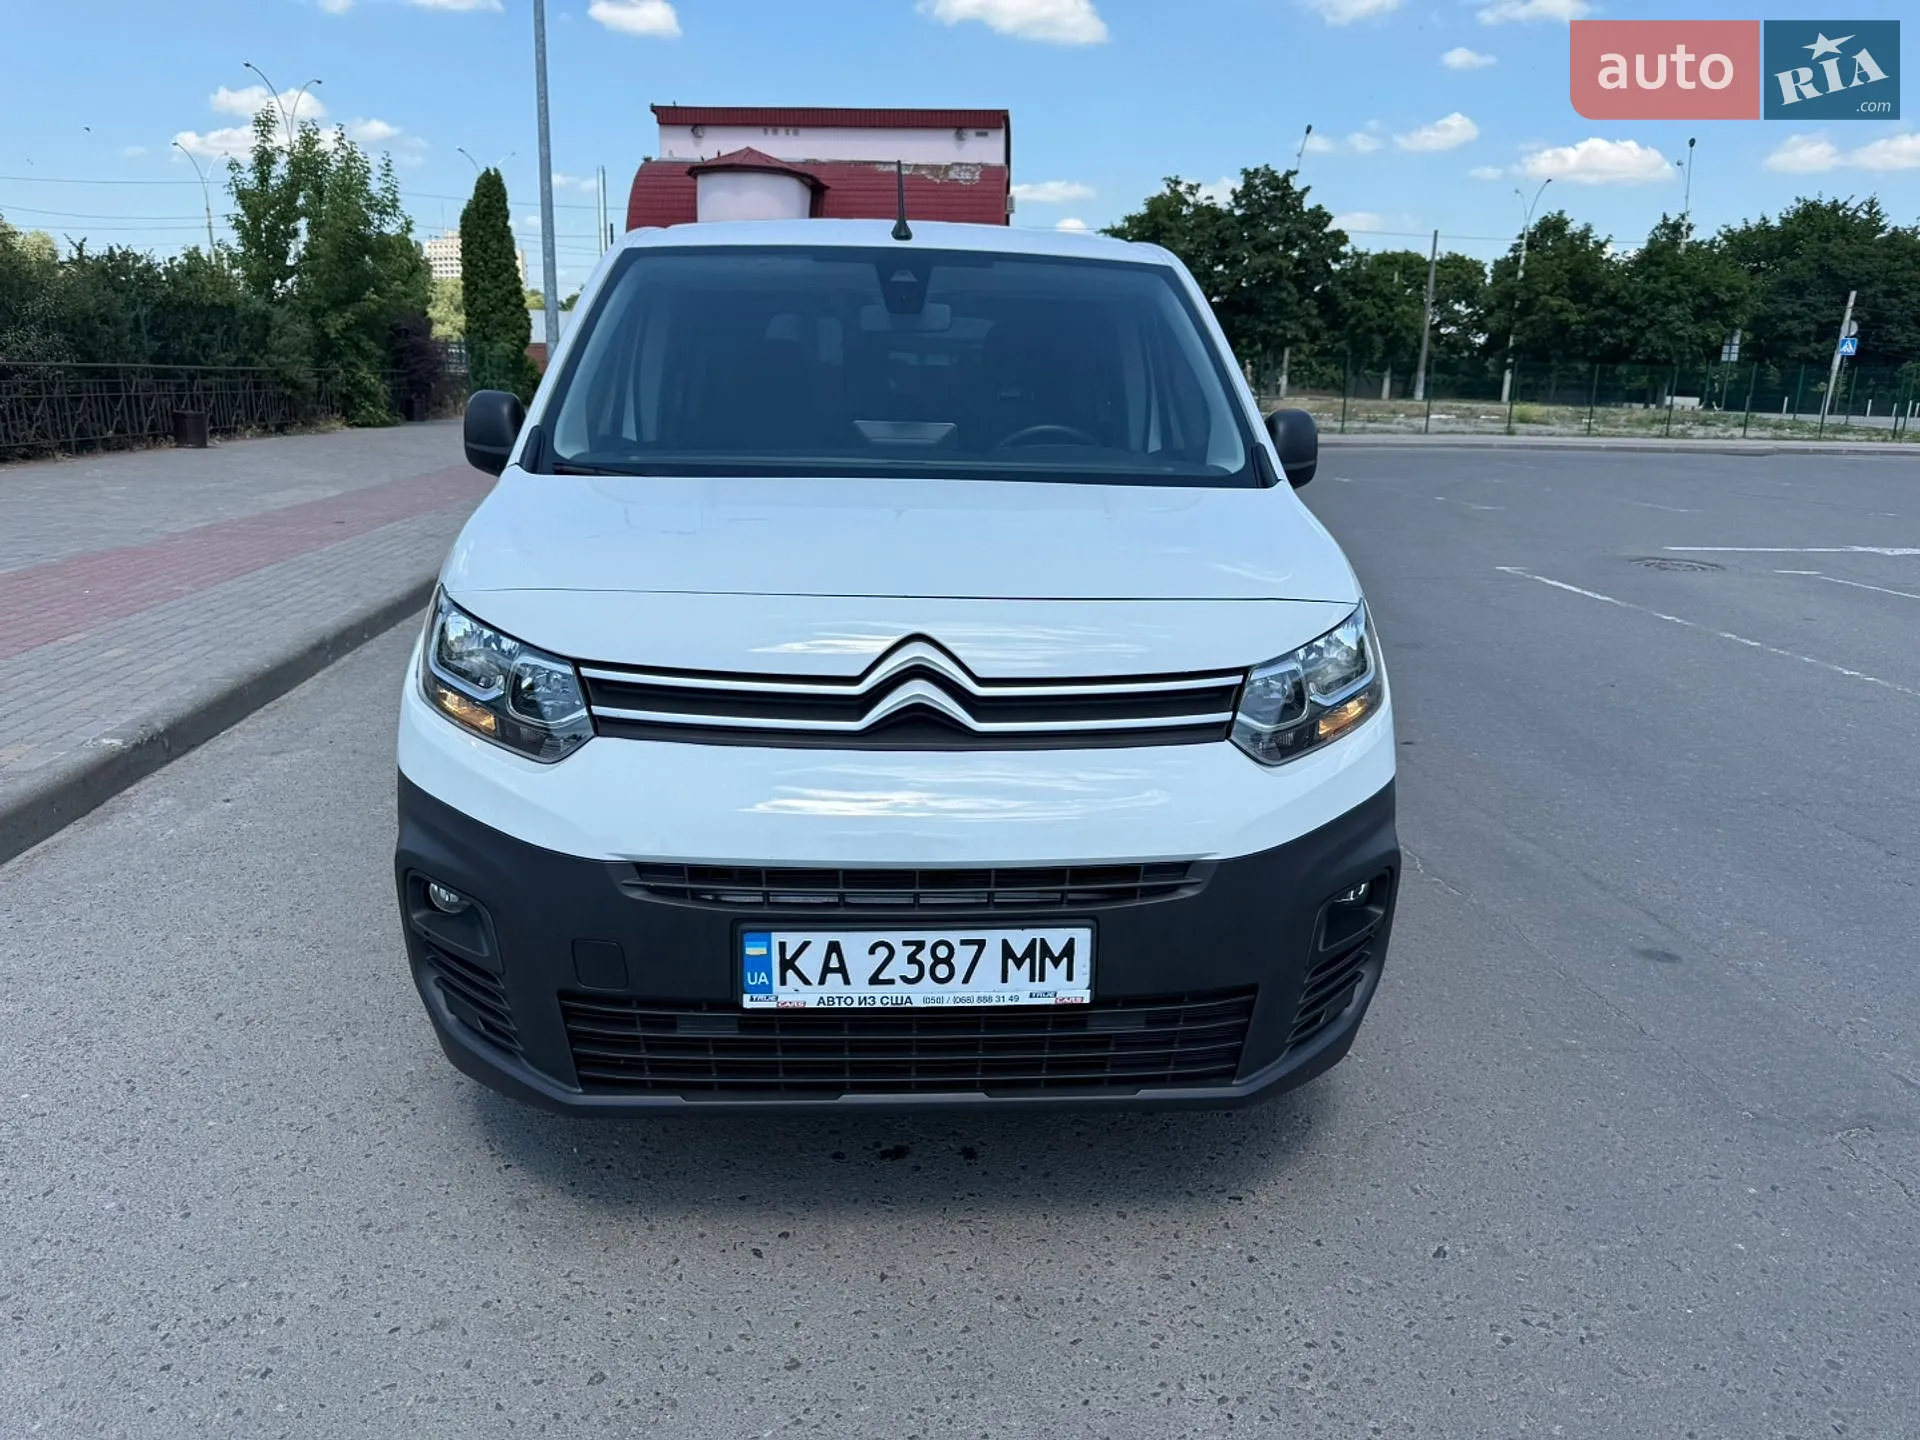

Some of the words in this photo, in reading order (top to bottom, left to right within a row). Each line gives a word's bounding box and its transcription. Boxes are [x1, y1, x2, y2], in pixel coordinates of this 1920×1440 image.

[778, 940, 851, 986] KA
[868, 939, 987, 985] 2387
[1001, 937, 1076, 984] MM
[747, 971, 769, 985] UA
[816, 996, 855, 1006] АВТО
[858, 995, 876, 1006] ИЗ
[880, 995, 913, 1006] США
